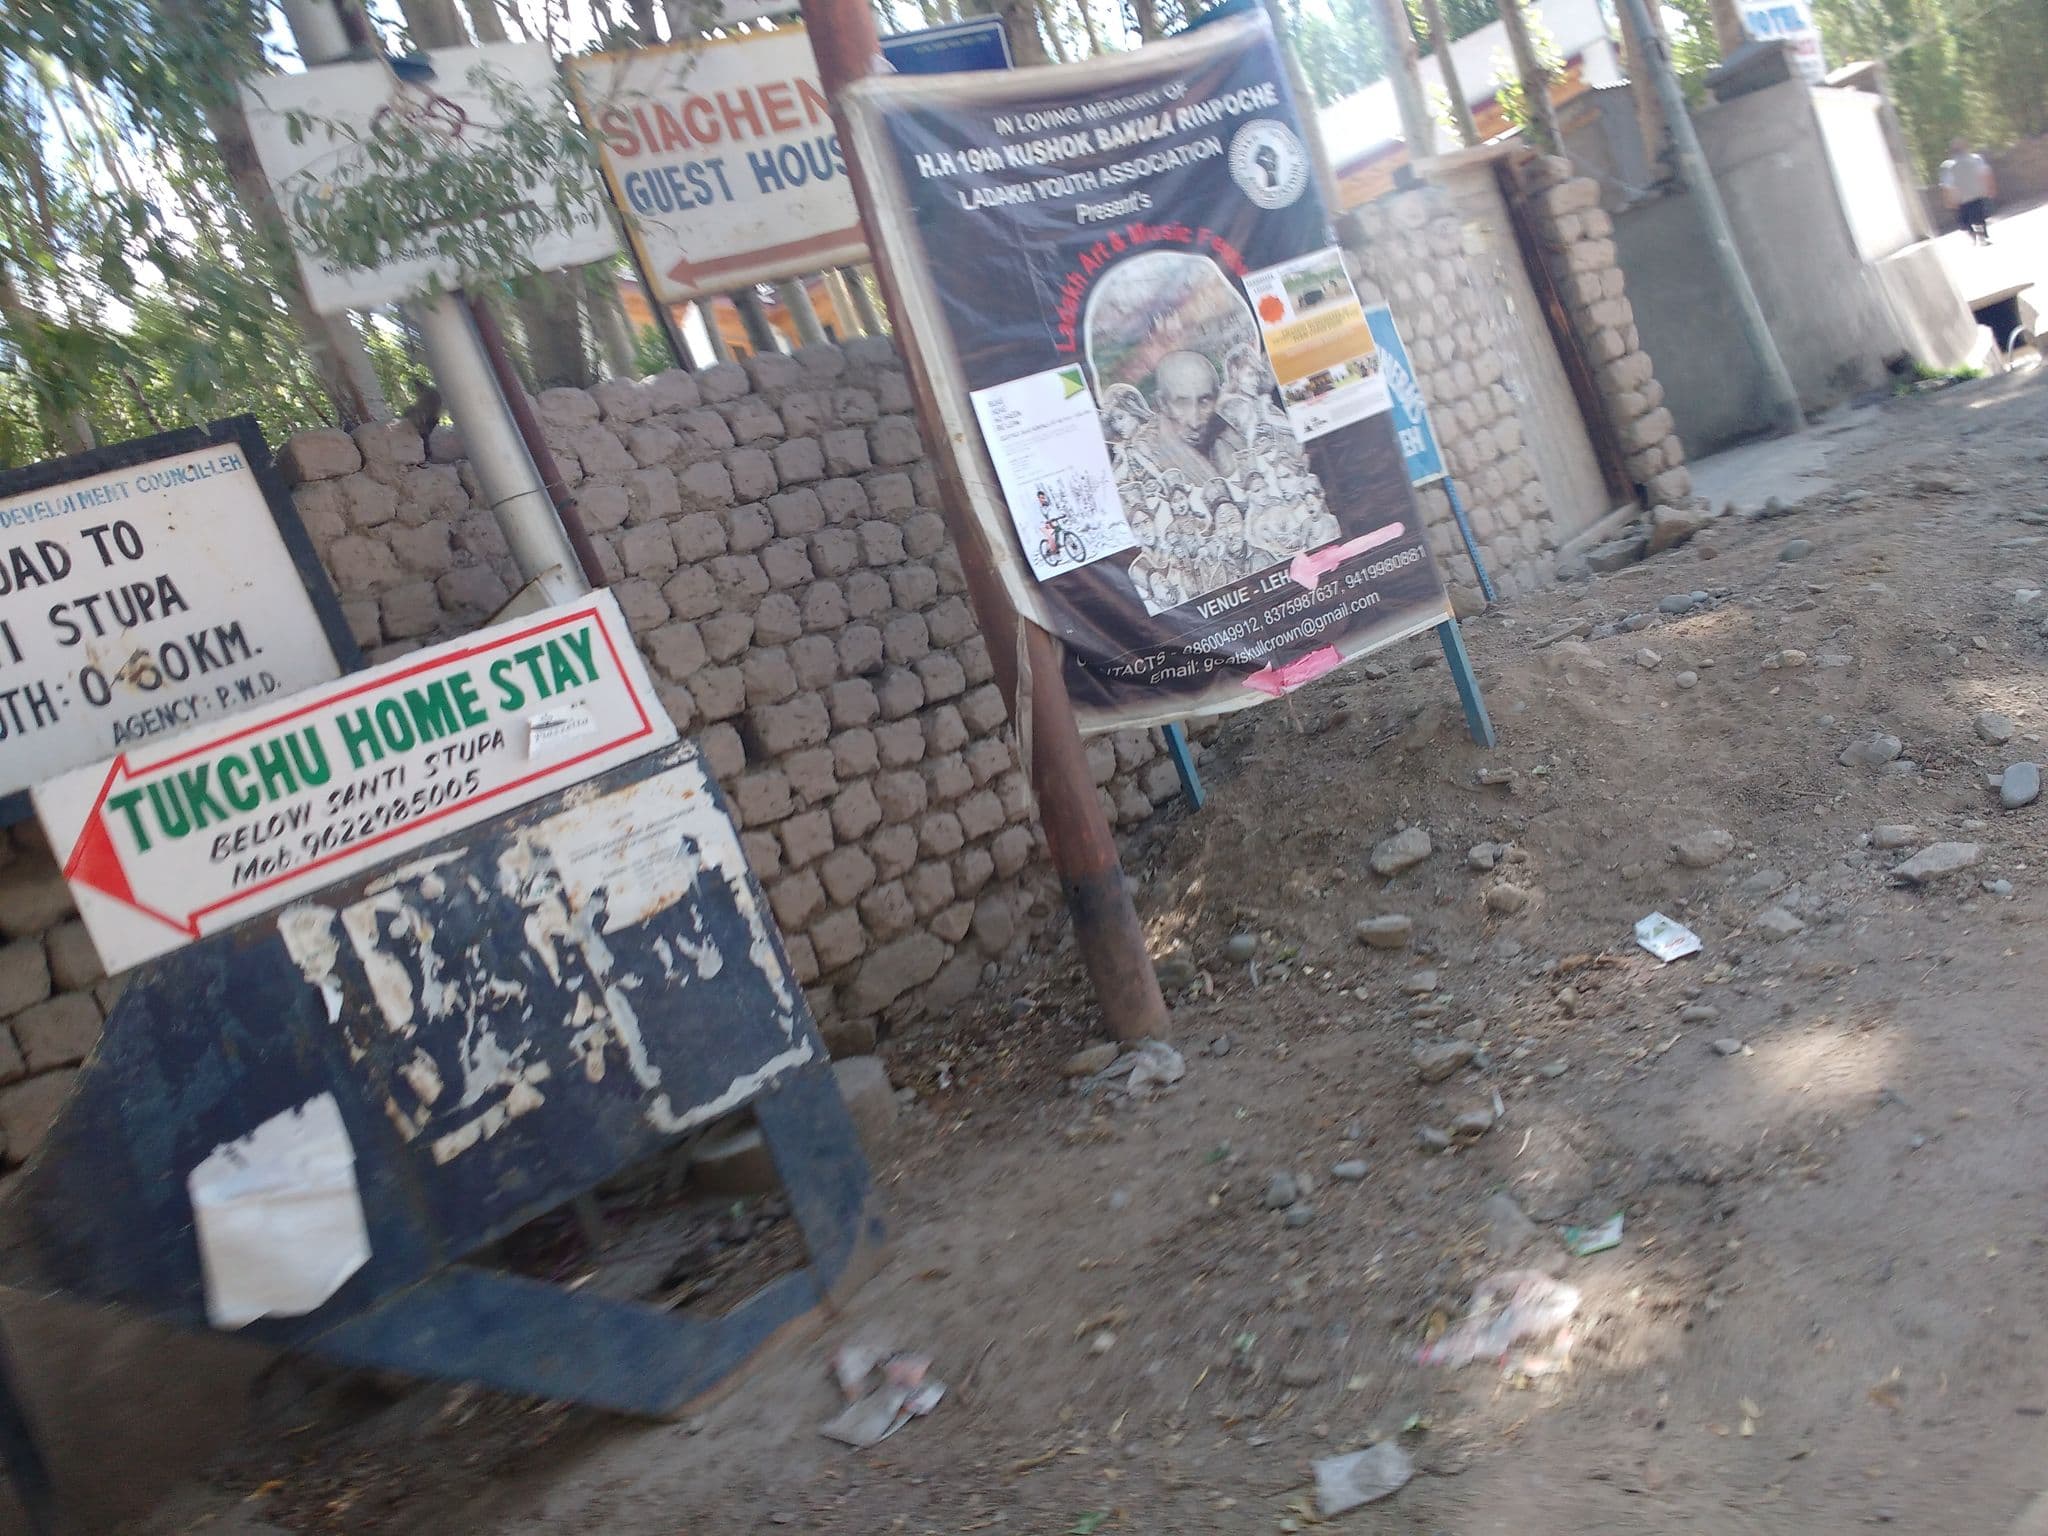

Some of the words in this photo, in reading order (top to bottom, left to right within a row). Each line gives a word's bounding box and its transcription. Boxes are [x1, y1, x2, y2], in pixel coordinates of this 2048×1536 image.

[599, 76, 831, 158] SIACHEN
[914, 151, 959, 178] H.H
[956, 146, 1006, 174] 19th
[1001, 131, 1097, 168] KUSHOK
[1092, 111, 1177, 151] BAKULA
[1175, 81, 1281, 132] RINPOCHE
[993, 114, 1015, 136] IN
[1013, 106, 1083, 134] LOVING
[1080, 88, 1160, 122] MEMORY
[624, 157, 736, 217] GUEST
[957, 181, 1037, 211] LADAKH
[1032, 170, 1100, 200] YOUTH
[1097, 135, 1224, 188] ASSOCIATION
[1074, 189, 1154, 225] Present's
[80, 519, 145, 567] TO
[49, 573, 191, 647] STUPA
[1196, 586, 1251, 620] VENUE
[1259, 567, 1293, 595] LEH
[1263, 580, 1345, 626] 8375987637,
[215, 671, 283, 710] P.W.D.
[1149, 658, 1200, 684] Email:
[106, 724, 333, 858] TUKCHU
[336, 670, 491, 770] HOME
[488, 625, 602, 712] STAY
[209, 800, 313, 864] BELOW
[327, 764, 407, 816] SANTI
[423, 727, 506, 779] STUPA
